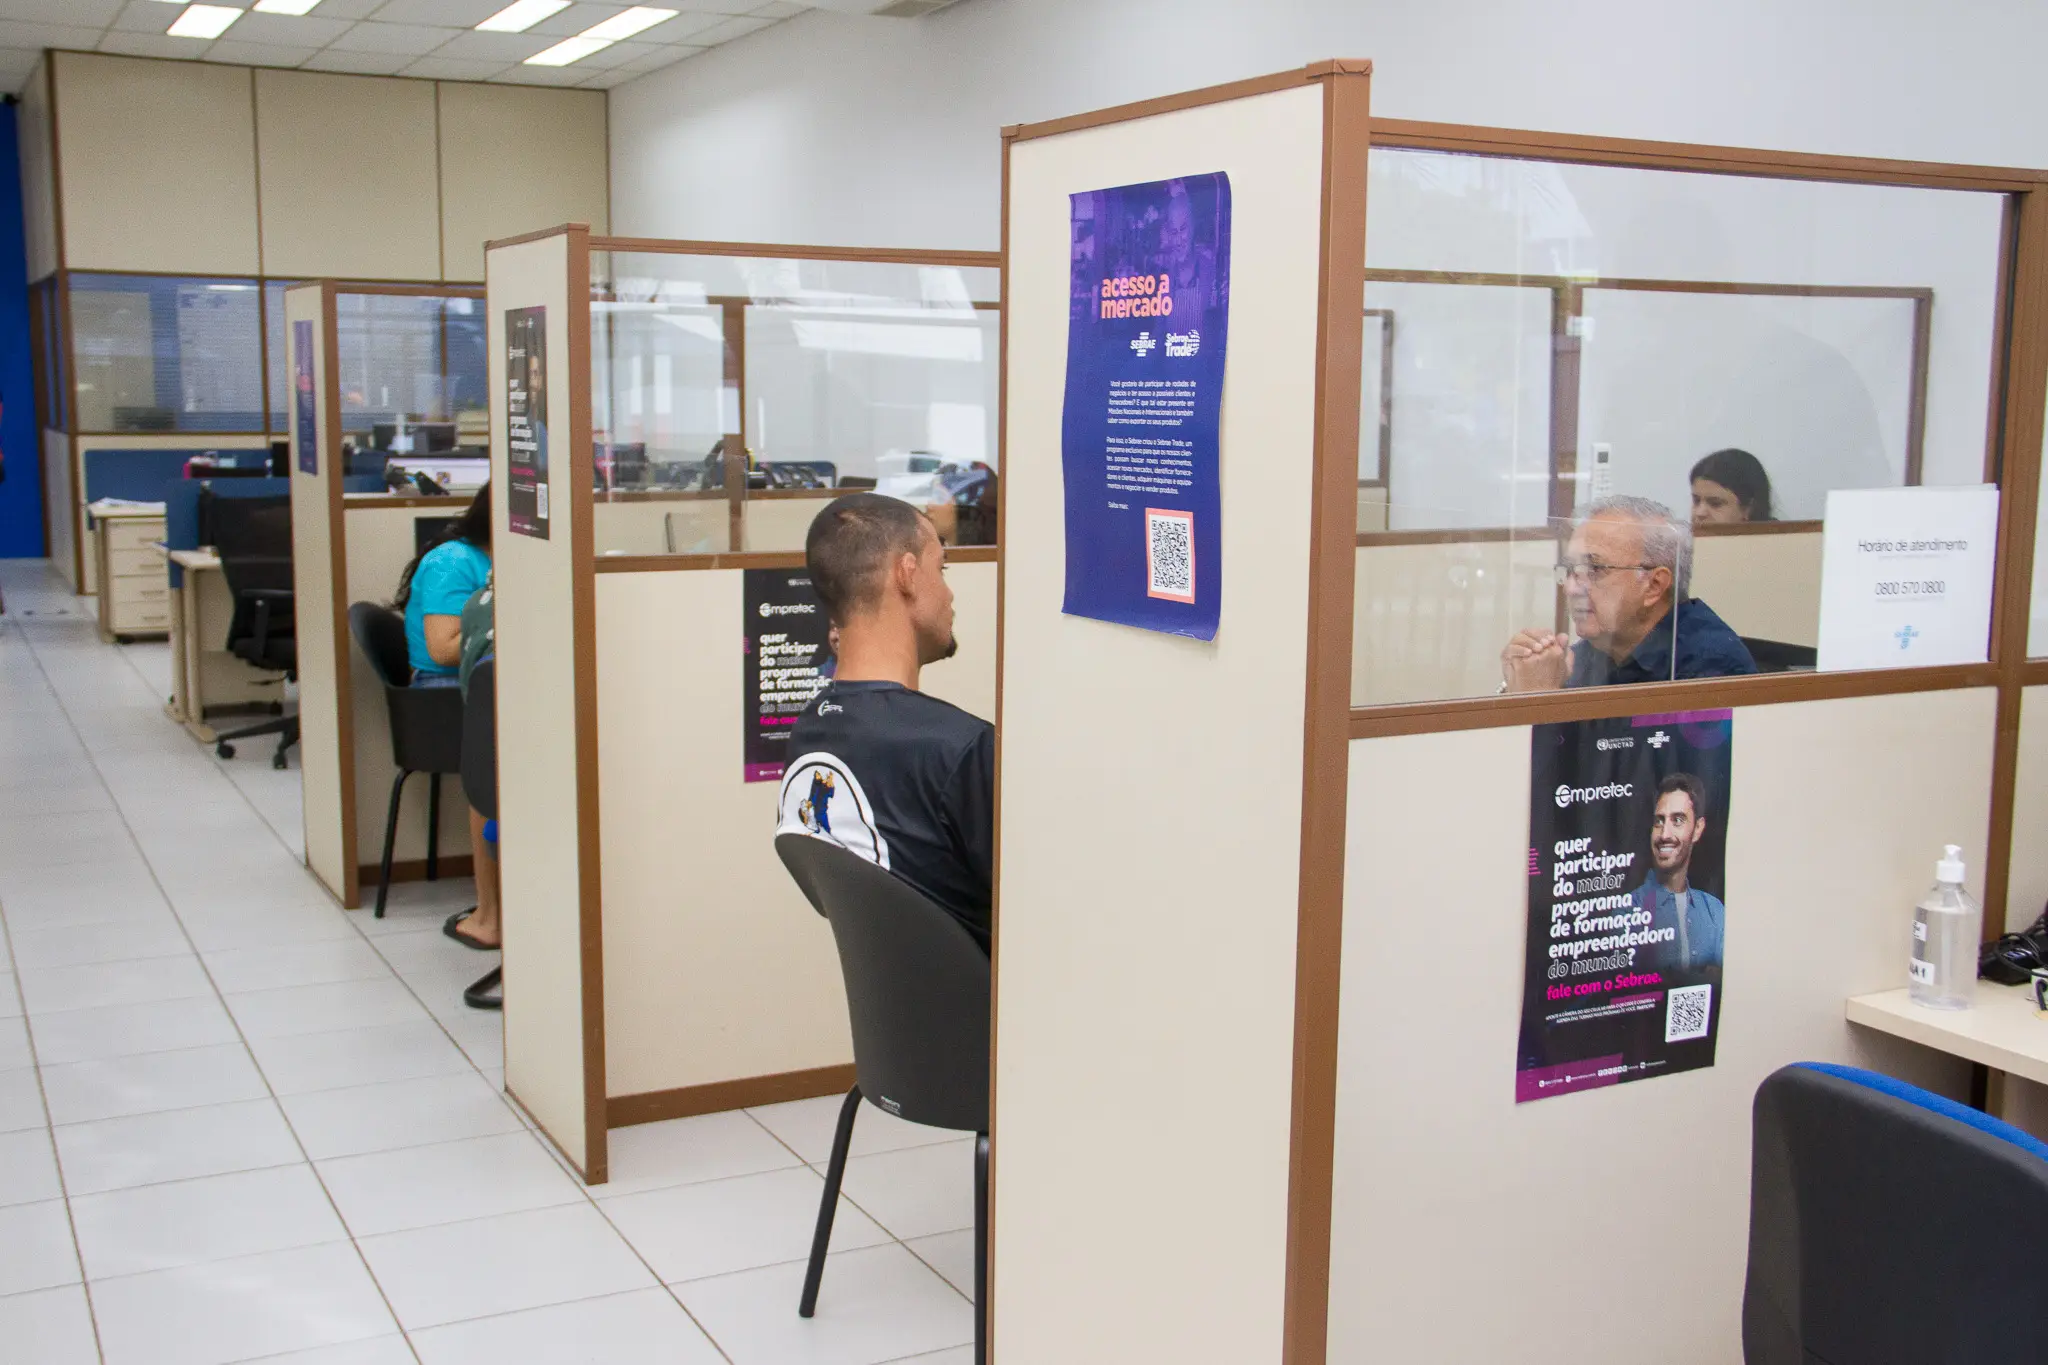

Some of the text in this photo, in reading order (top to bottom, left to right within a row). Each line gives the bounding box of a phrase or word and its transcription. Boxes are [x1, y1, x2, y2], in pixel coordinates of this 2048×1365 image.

[1101, 274, 1170, 297] acesso a
[1101, 291, 1172, 319] mercado
[1130, 340, 1156, 349] SEBRAE
[1166, 333, 1189, 343] Sebrae
[1164, 342, 1192, 356] Trade
[1858, 540, 1968, 552] Horário de atendimento
[1875, 581, 1945, 595] 0800 570 0800
[760, 634, 788, 646] quer
[760, 641, 819, 657] participar
[760, 656, 812, 667] do maior
[760, 667, 818, 681] programa
[760, 679, 774, 690] de
[760, 701, 775, 713] do
[760, 716, 778, 725] fale
[1608, 741, 1634, 749] UNCTAD
[1554, 837, 1592, 860] quer
[1554, 850, 1635, 881] participar
[1553, 871, 1625, 897] do maior
[1552, 893, 1632, 922] programa
[1550, 907, 1652, 938] de formação
[1549, 926, 1674, 959] empreendedora
[1548, 948, 1636, 979] do mundo?
[1547, 972, 1662, 1000] fale com o Sebrae.
